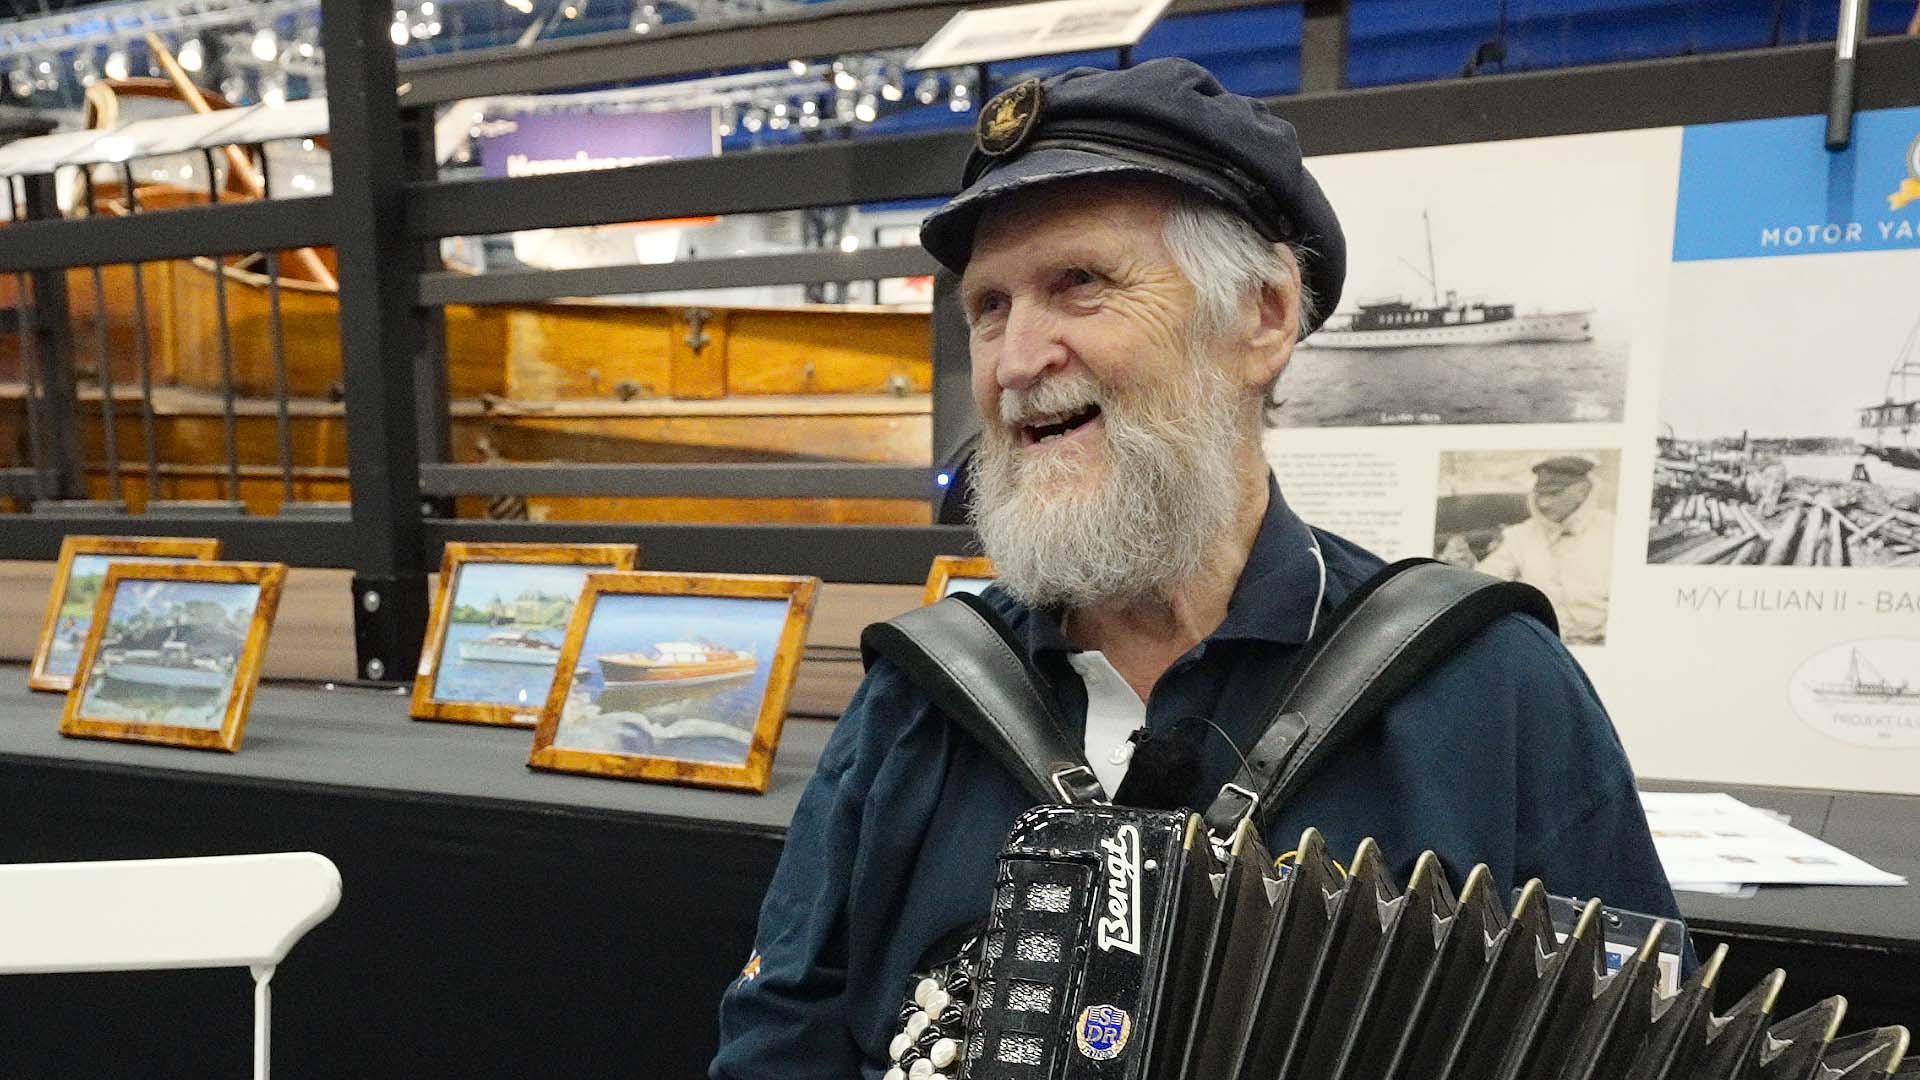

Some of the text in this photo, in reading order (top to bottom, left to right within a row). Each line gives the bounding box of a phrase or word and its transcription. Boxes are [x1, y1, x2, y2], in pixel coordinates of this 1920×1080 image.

[1760, 222, 1864, 248] MOTOR
[1675, 585, 1730, 611] M/Y
[1736, 588, 1824, 612] LILIAN
[1875, 591, 1920, 614] BA
[1098, 824, 1141, 956] Bengt
